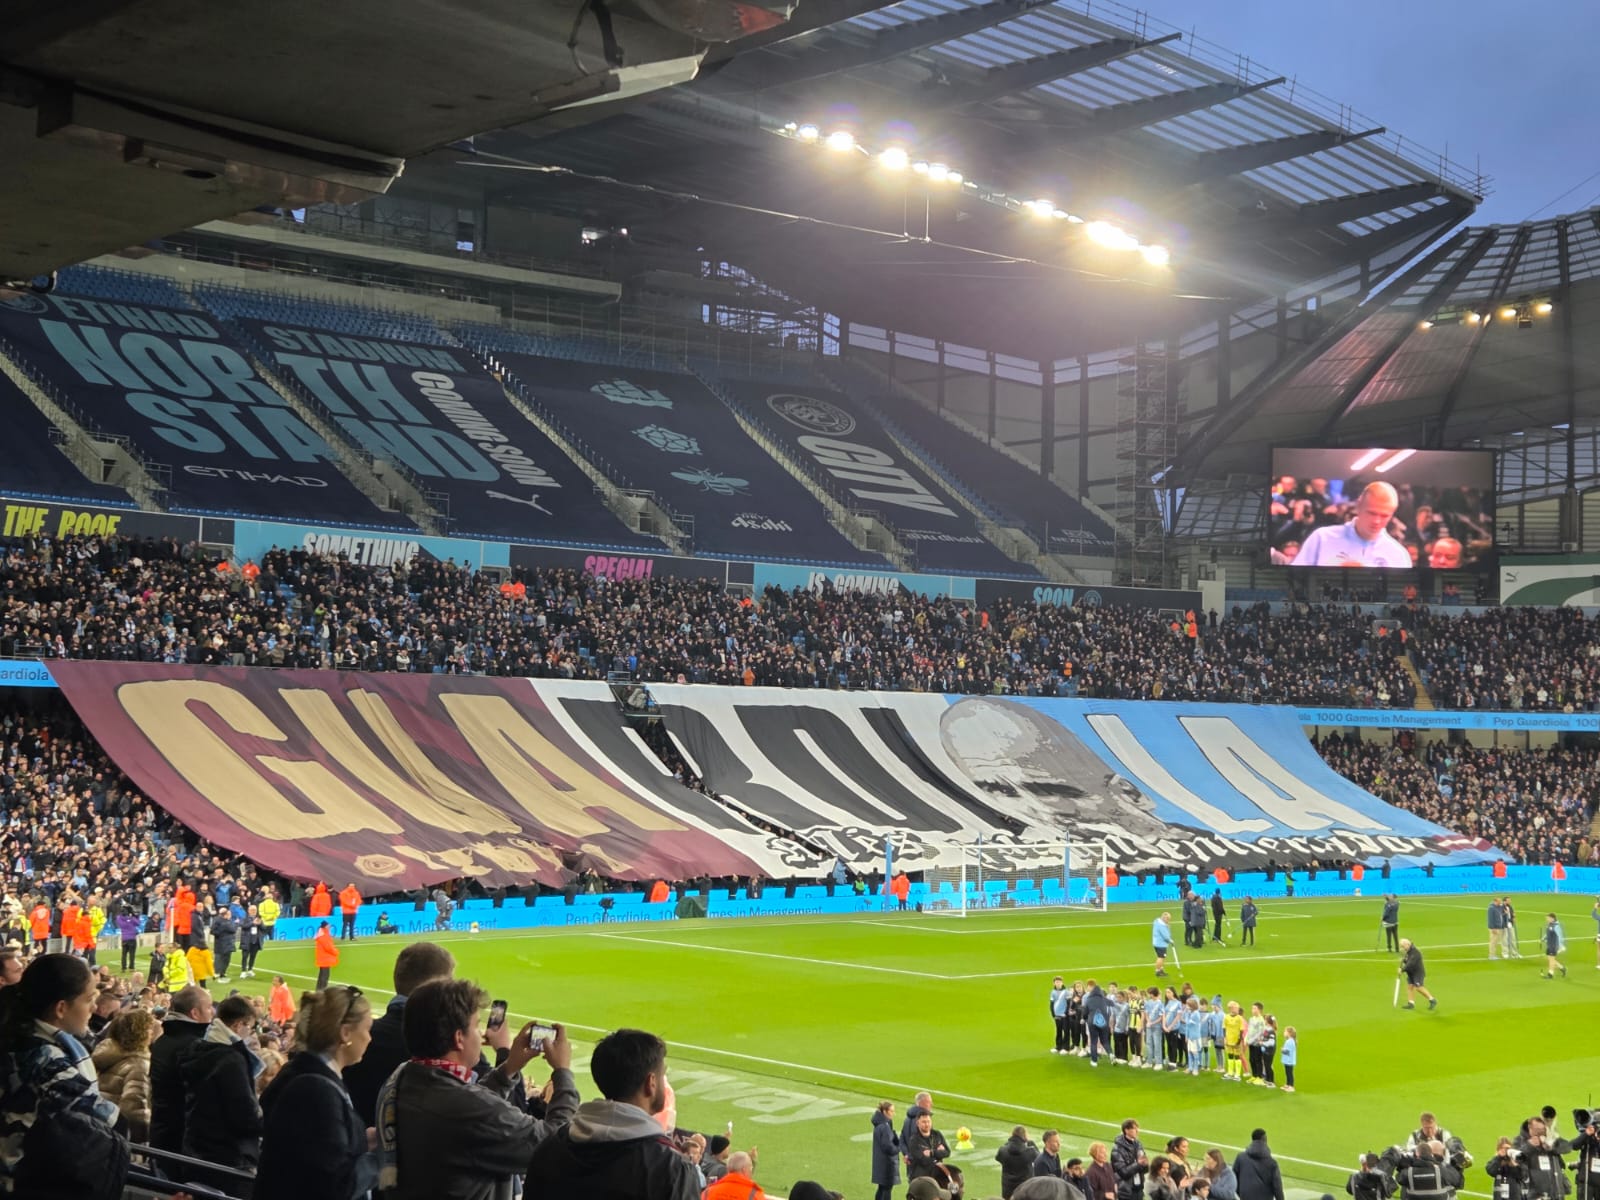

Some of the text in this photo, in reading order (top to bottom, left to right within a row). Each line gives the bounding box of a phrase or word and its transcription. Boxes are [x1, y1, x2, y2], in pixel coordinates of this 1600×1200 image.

[48, 294, 220, 339] ETIHAD
[263, 326, 467, 373] STADIUM
[411, 371, 562, 488] COMING SOON
[184, 465, 329, 488] ETIHAD
[3, 505, 49, 538] THE
[302, 532, 420, 567] SOMETHING
[582, 555, 654, 583] SPECIAL
[807, 571, 900, 599] IS COMING
[1033, 586, 1075, 610] SOON
[0, 668, 49, 681] ardiola
[1316, 712, 1344, 723] 1000
[1345, 713, 1380, 724] Games
[1381, 714, 1391, 724] in
[1392, 714, 1462, 727] Management
[1493, 718, 1515, 729] Pep
[1516, 717, 1571, 729] Guardiola
[1575, 718, 1600, 728] 100
[118, 679, 1393, 841] GUARDILA
